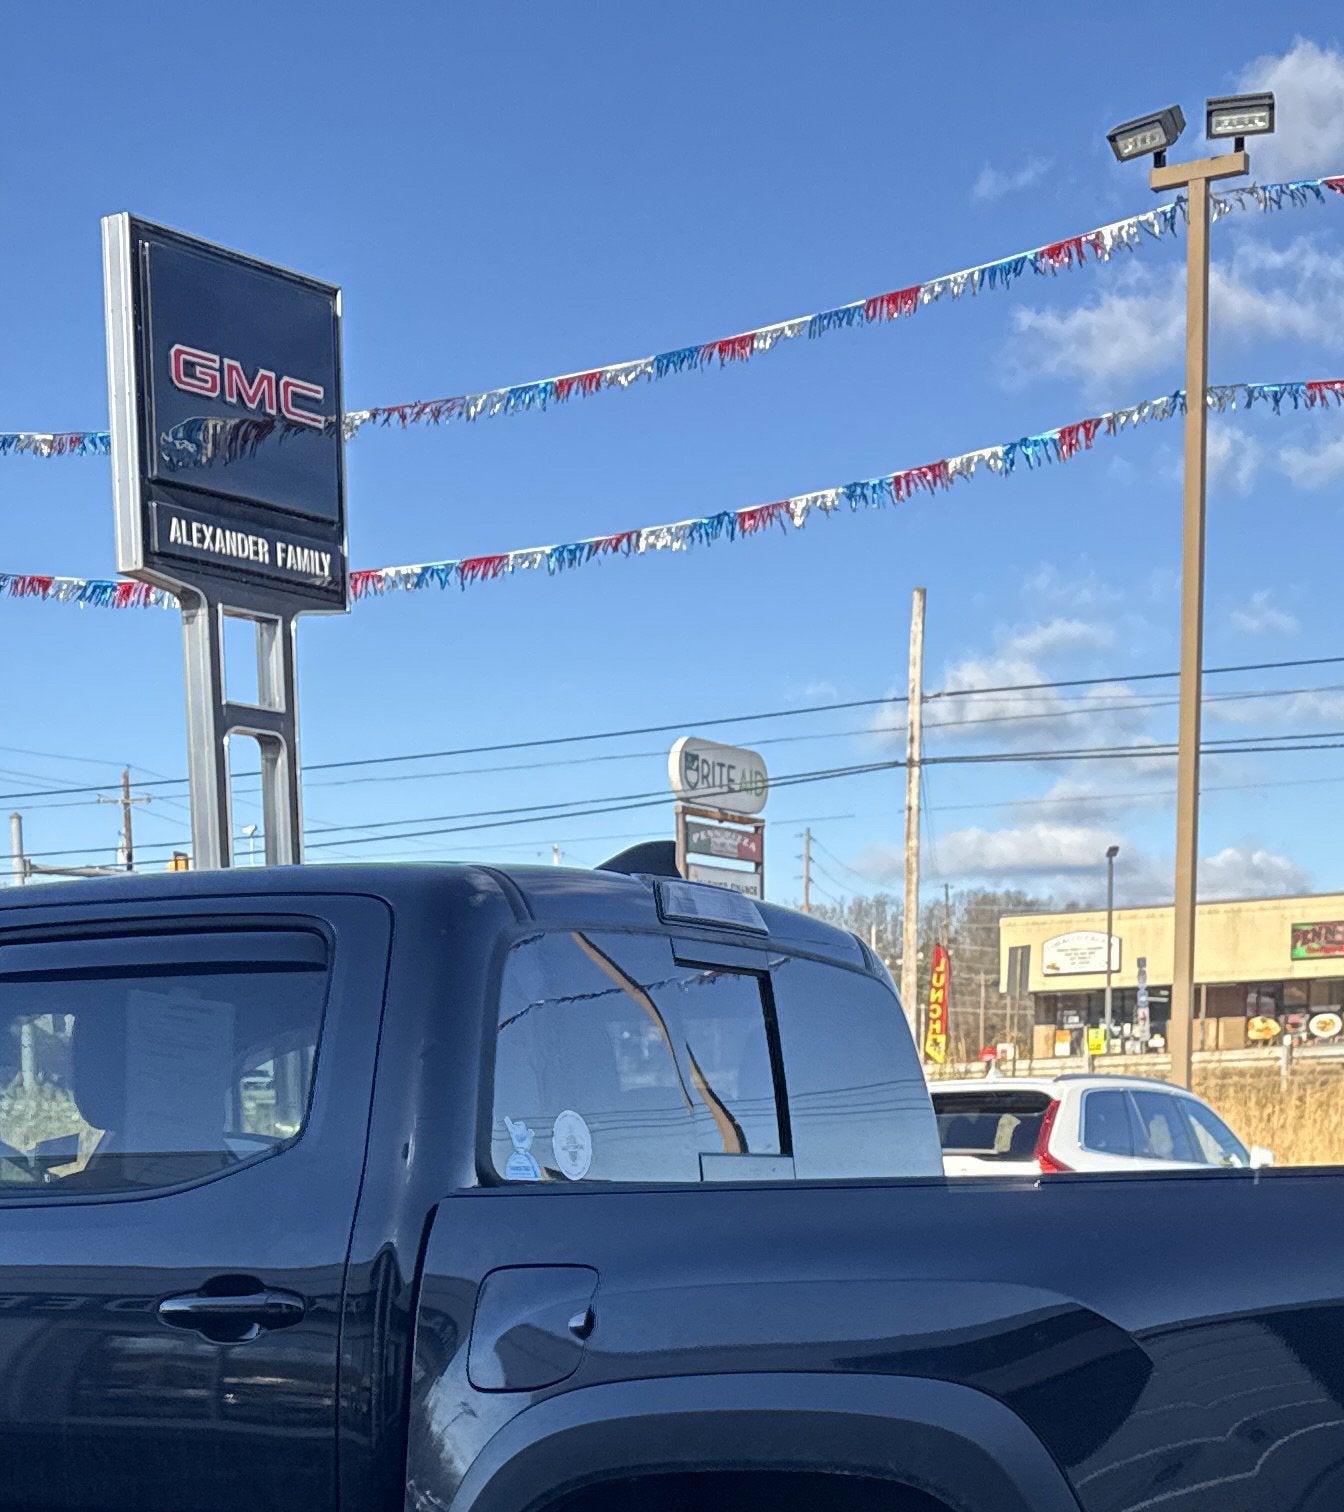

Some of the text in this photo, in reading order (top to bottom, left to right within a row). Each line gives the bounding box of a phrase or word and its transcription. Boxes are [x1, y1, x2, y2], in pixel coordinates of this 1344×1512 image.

[170, 343, 324, 429] GMC
[169, 516, 331, 578] ALEXANDER FAMILY
[701, 758, 766, 797] RITE AID
